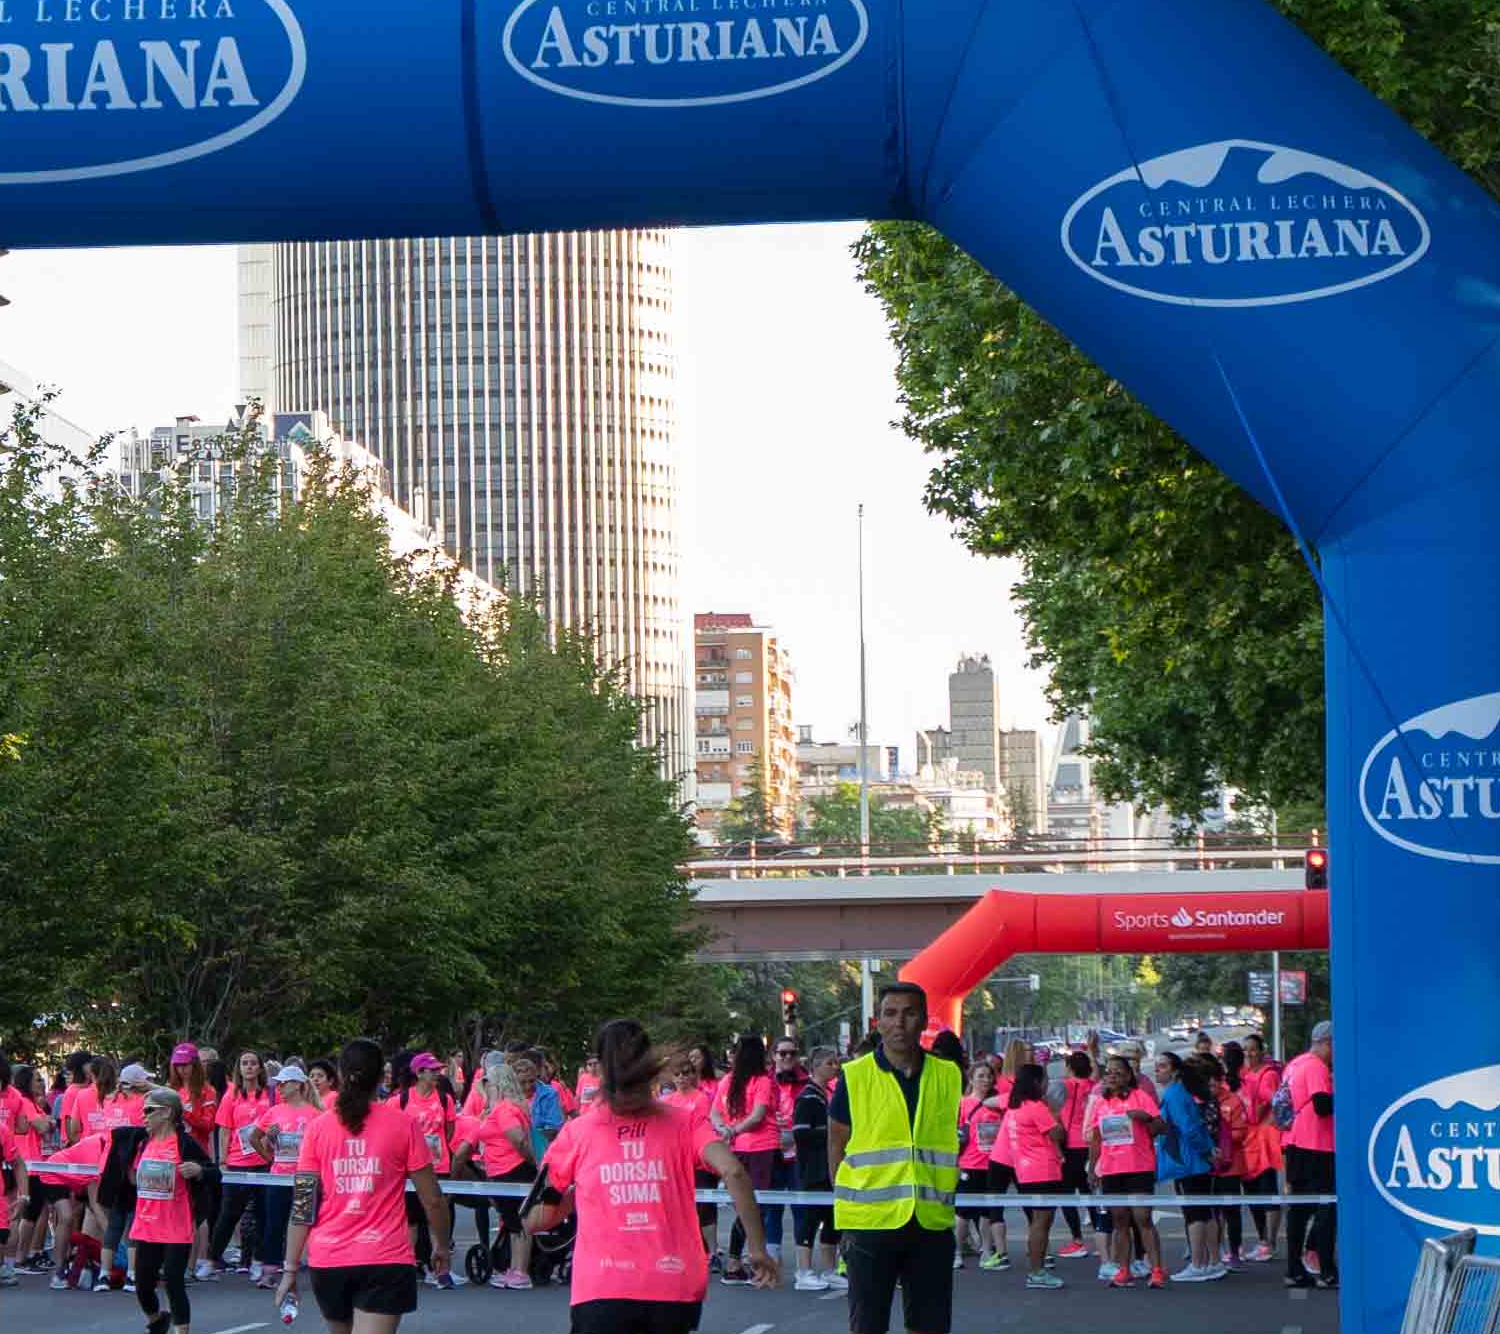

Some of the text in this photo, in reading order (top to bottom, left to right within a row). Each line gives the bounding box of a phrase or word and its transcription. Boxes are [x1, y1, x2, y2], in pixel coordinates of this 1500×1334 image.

[532, 6, 840, 67] ASTURIANA
[1139, 194, 1386, 217] CENTRAL LECHERA
[1092, 207, 1405, 267] ASTURIANA
[1114, 910, 1285, 930] Sports Santander
[345, 1139, 366, 1156] TU
[620, 1141, 645, 1159] TU
[600, 1161, 668, 1183] DORSAL
[610, 1183, 661, 1205] SUMA
